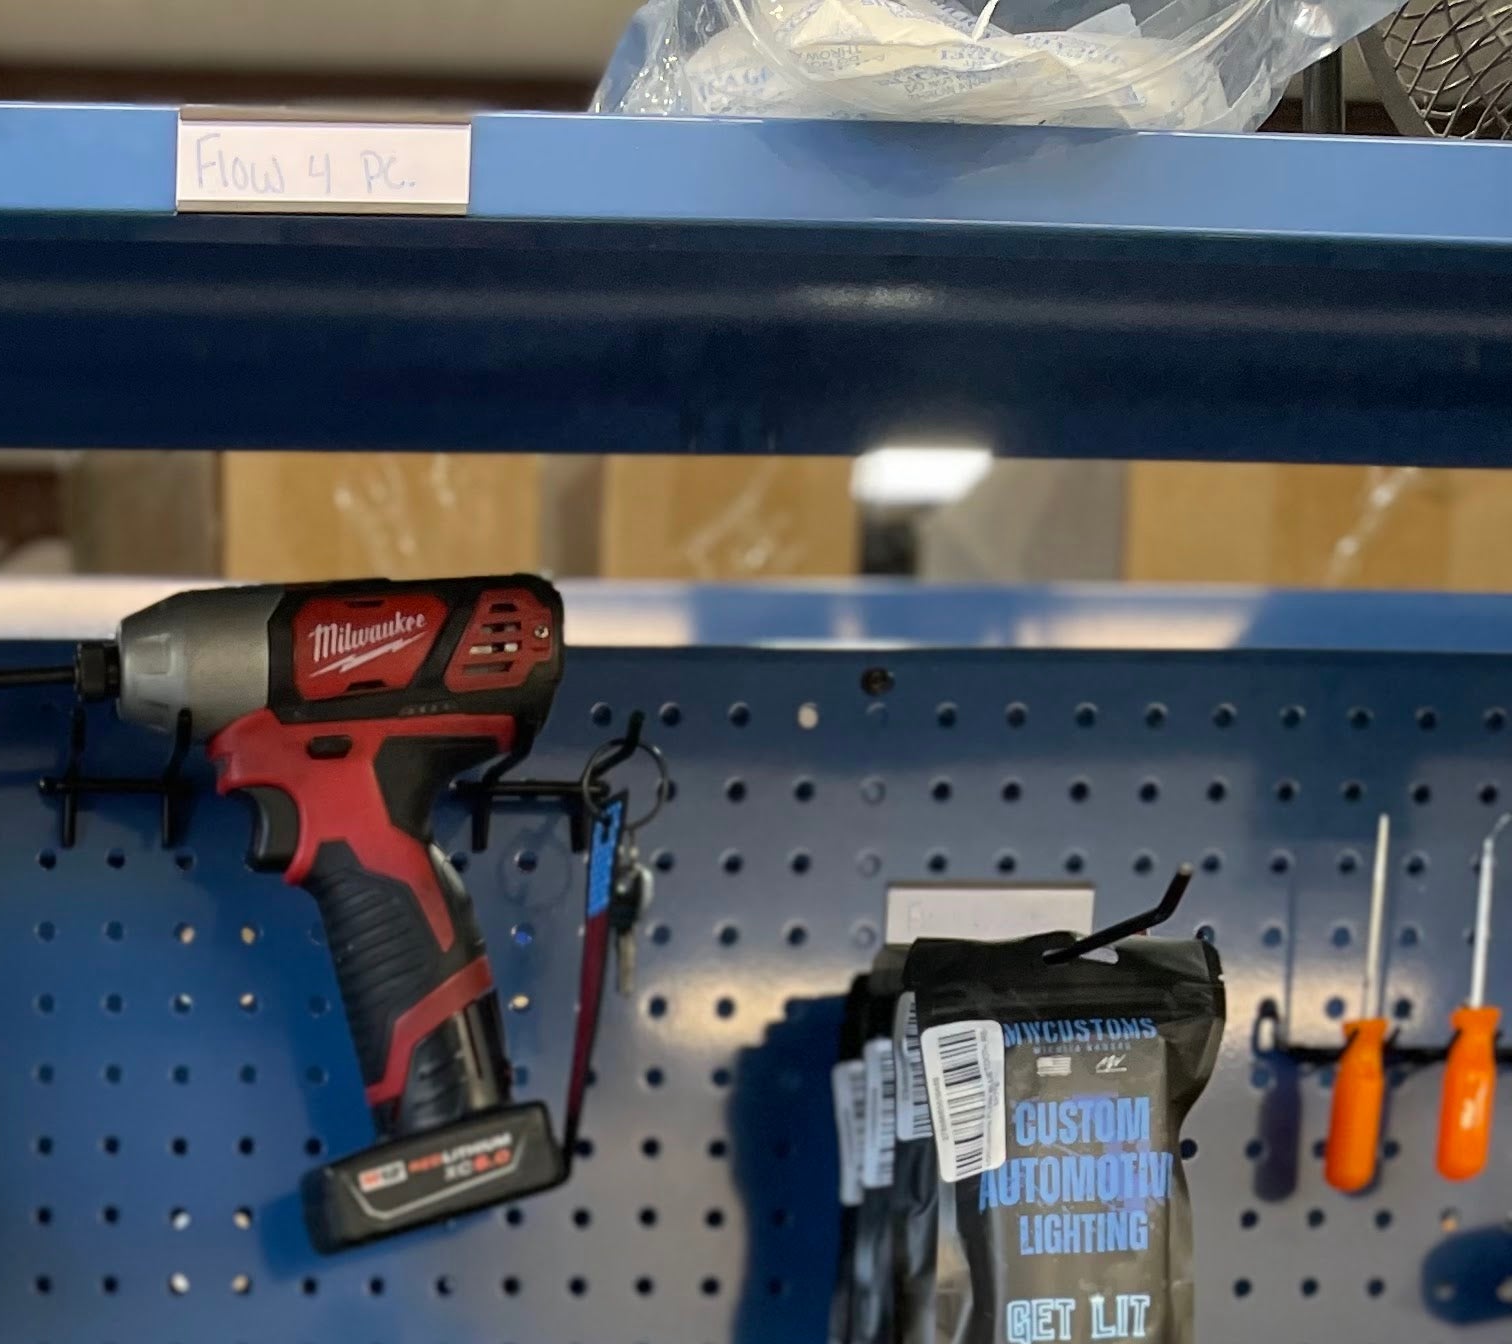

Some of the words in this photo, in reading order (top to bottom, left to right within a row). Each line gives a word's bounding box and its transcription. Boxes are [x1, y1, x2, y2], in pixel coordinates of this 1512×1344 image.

[195, 132, 285, 194] Flow
[309, 154, 332, 194] 4
[308, 611, 428, 662] Milwaukee
[1003, 1017, 1158, 1047] MWCUSTOMS
[1014, 1097, 1150, 1146] CUSTOM
[979, 1152, 1174, 1214] AUTOMOTIV
[1019, 1209, 1149, 1256] LIGHTING
[1090, 1294, 1151, 1339] LIT
